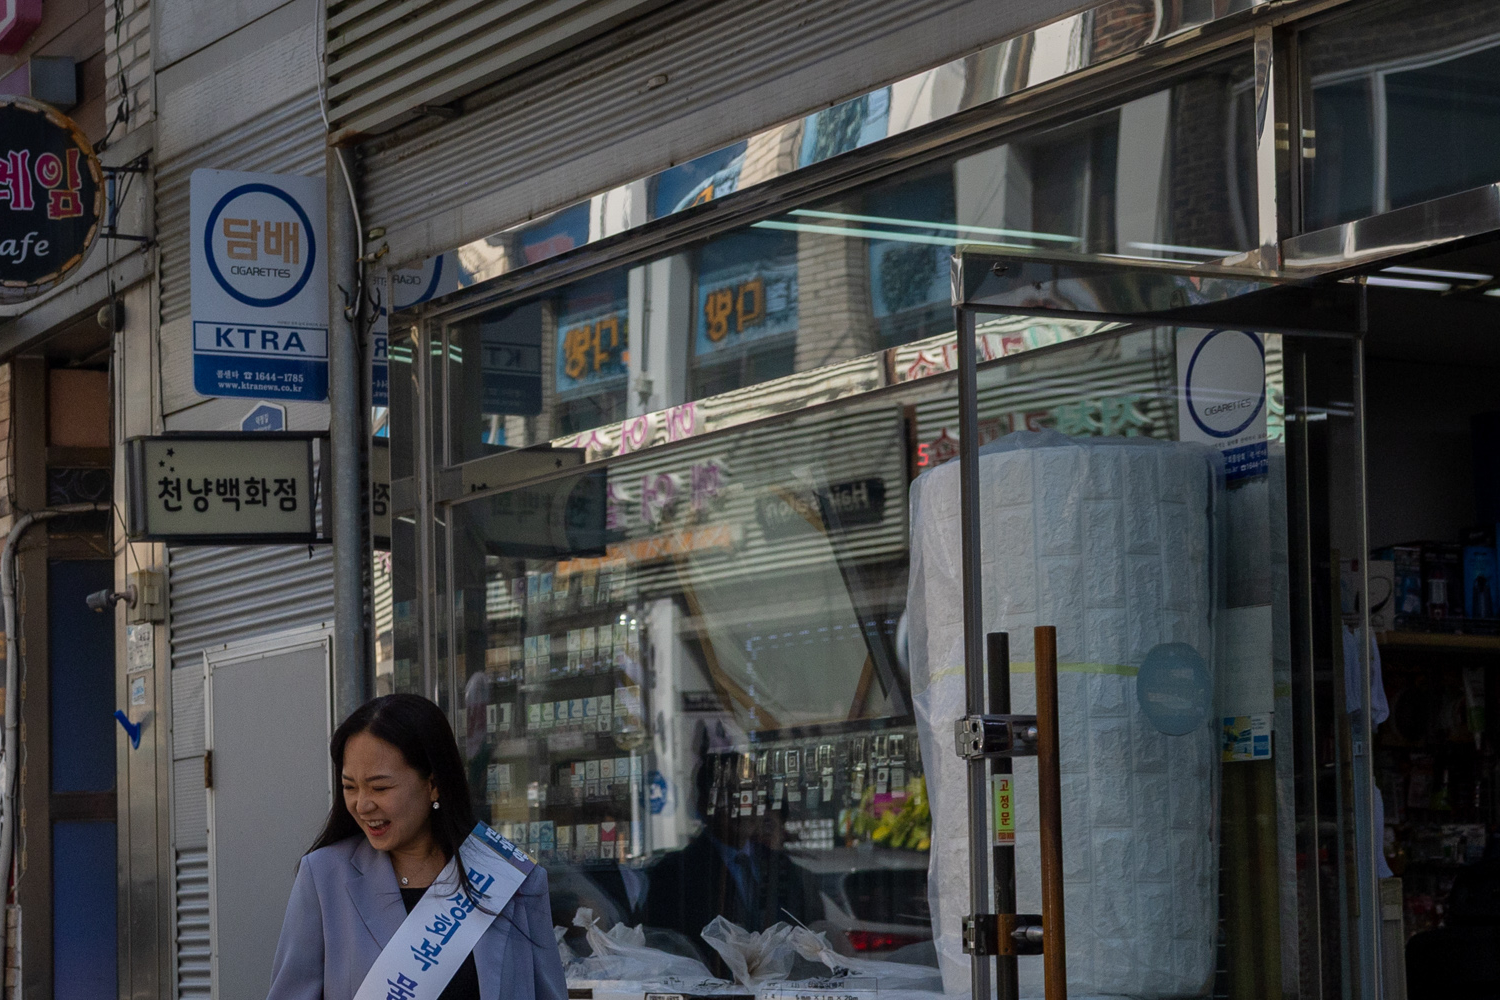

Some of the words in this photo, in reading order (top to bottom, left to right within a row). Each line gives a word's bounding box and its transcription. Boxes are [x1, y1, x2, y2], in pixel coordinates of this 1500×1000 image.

[223, 217, 300, 266] 담배
[230, 265, 291, 279] CIGARETTES
[215, 327, 306, 353] KTRA
[217, 381, 303, 394] www.ktranews.co.kr
[255, 371, 305, 384] 1644-1785
[157, 474, 298, 514] 천냥백화점
[999, 778, 1011, 827] 고정문
[410, 866, 497, 972] 민생회복
